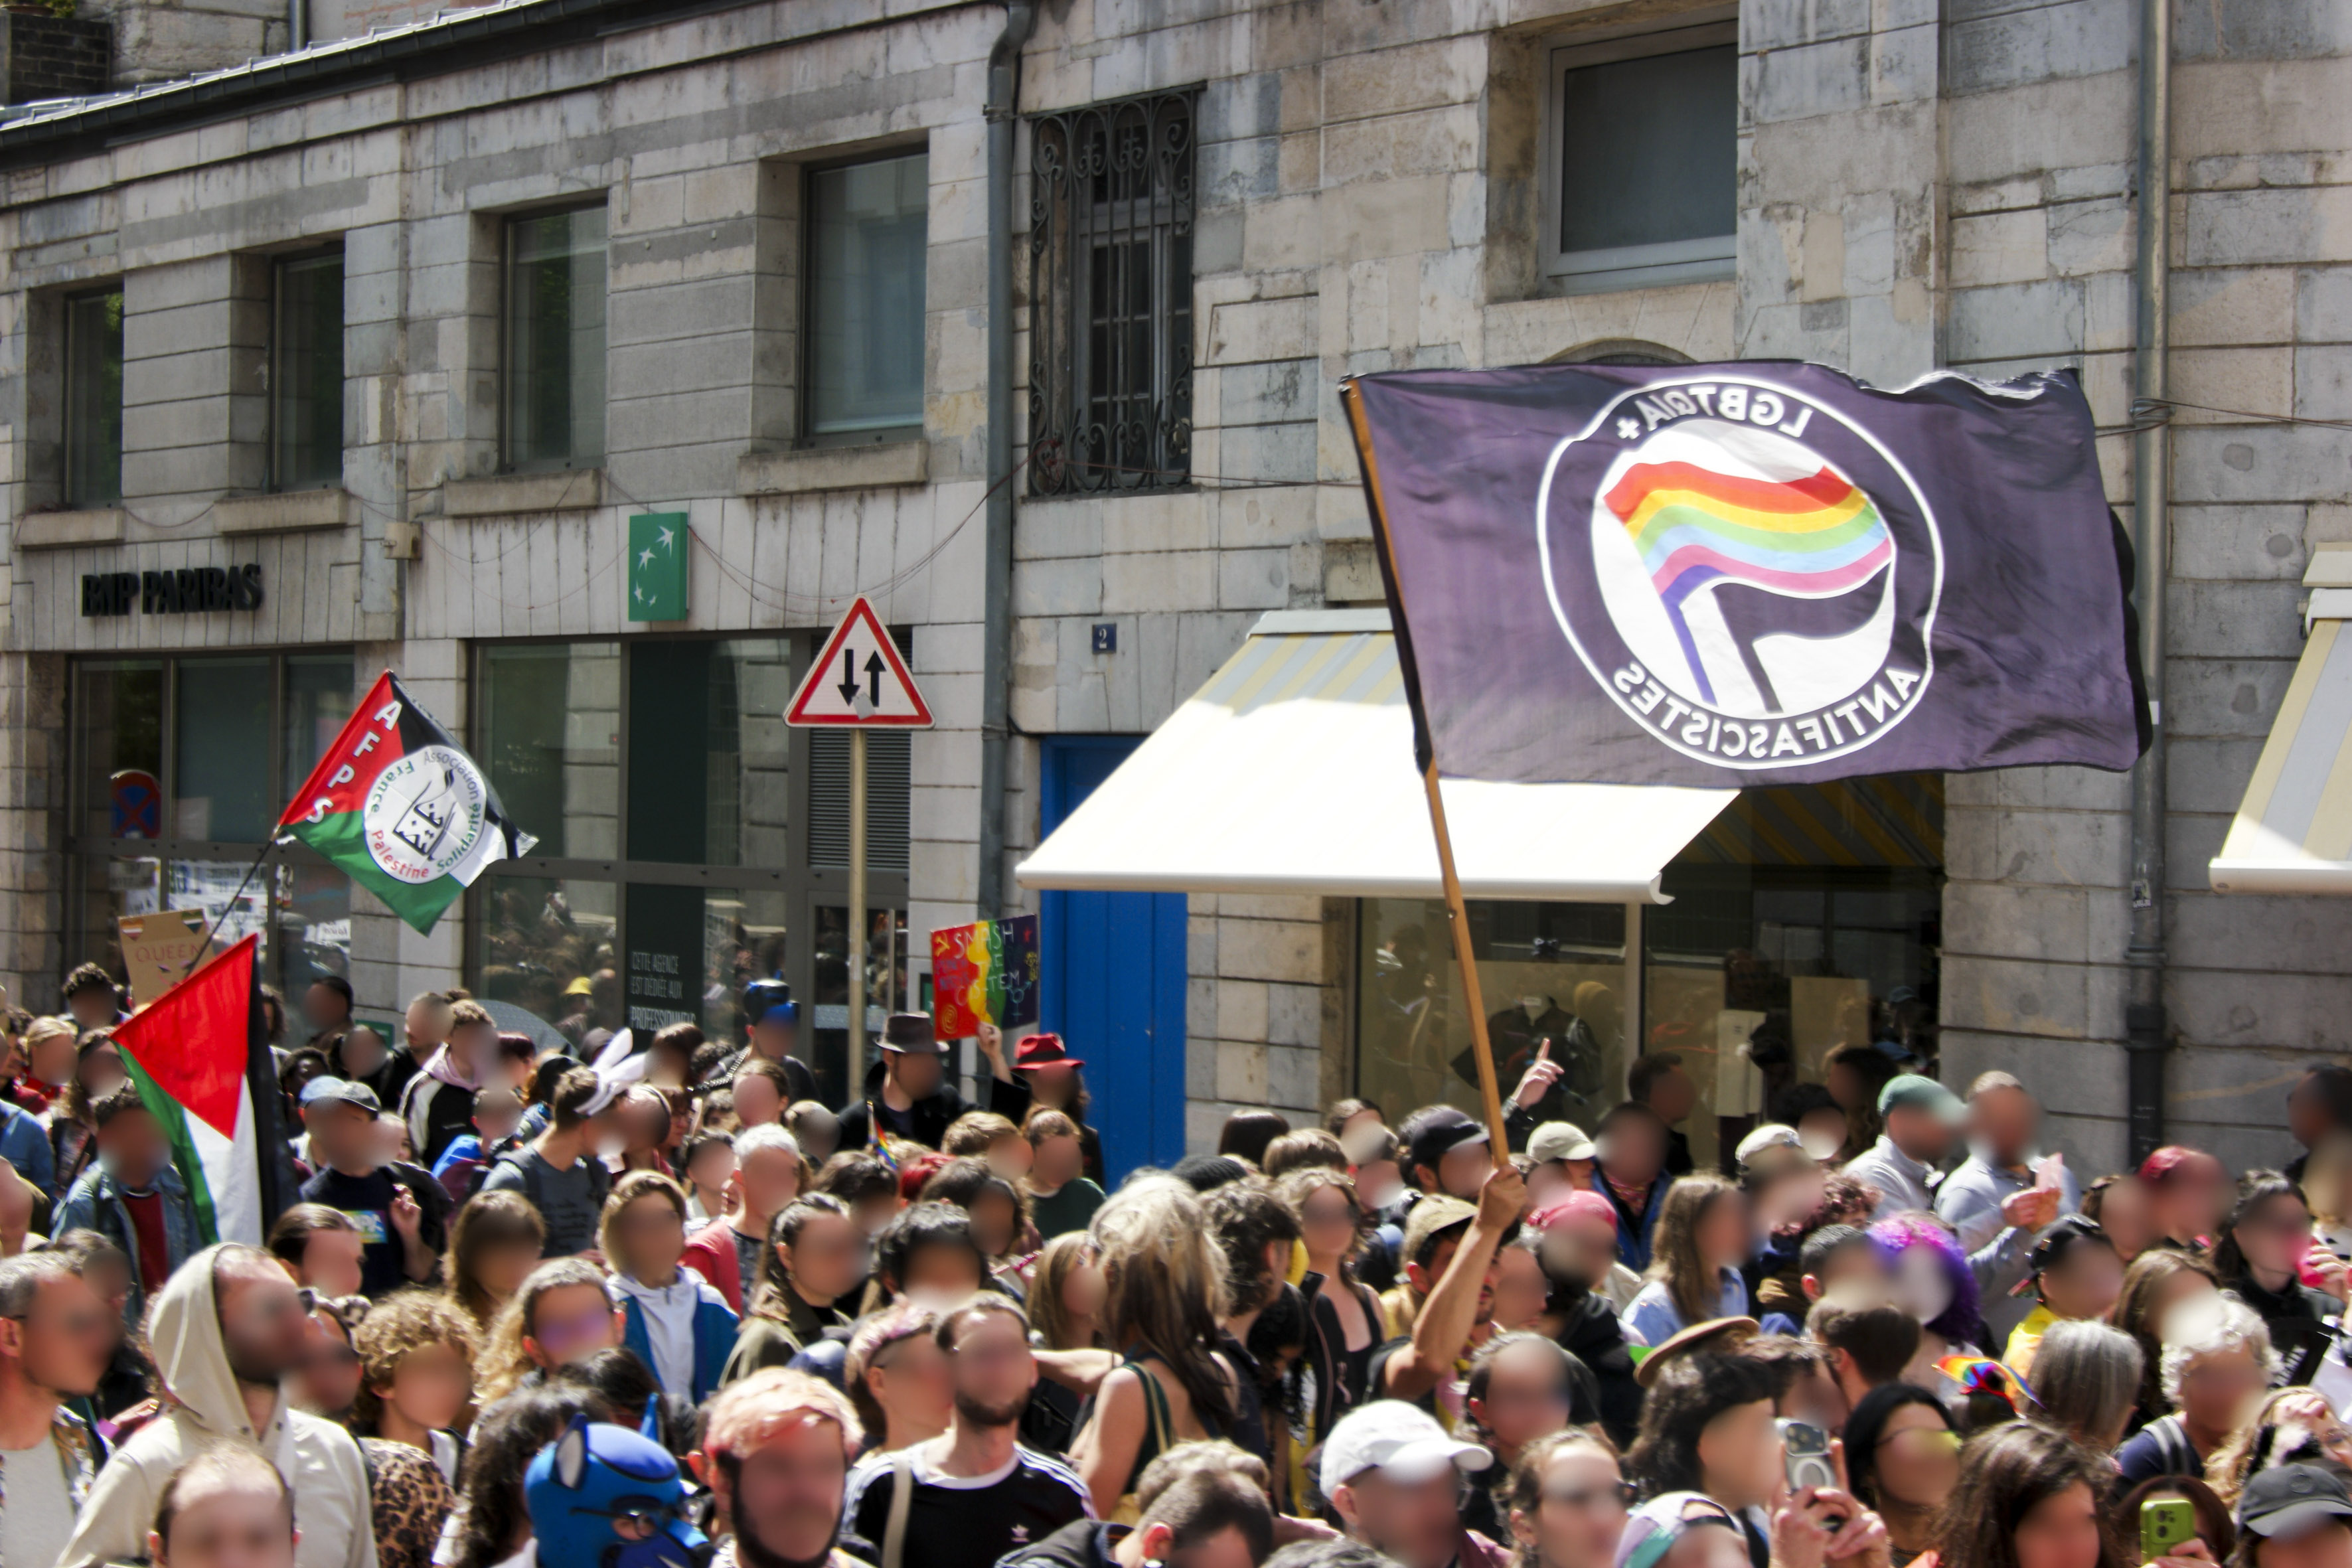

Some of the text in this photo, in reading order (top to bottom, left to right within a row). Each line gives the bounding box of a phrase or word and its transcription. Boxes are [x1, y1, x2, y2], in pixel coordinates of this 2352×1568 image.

[82, 564, 264, 617] BNP PARIBAS
[1099, 628, 1107, 649] 2
[370, 751, 482, 879] Association France Palestine Solidarité
[953, 922, 1015, 959] SMASH
[632, 951, 679, 975] CETTE AGENCE
[631, 976, 643, 994] EST
[668, 980, 683, 1000] AUX
